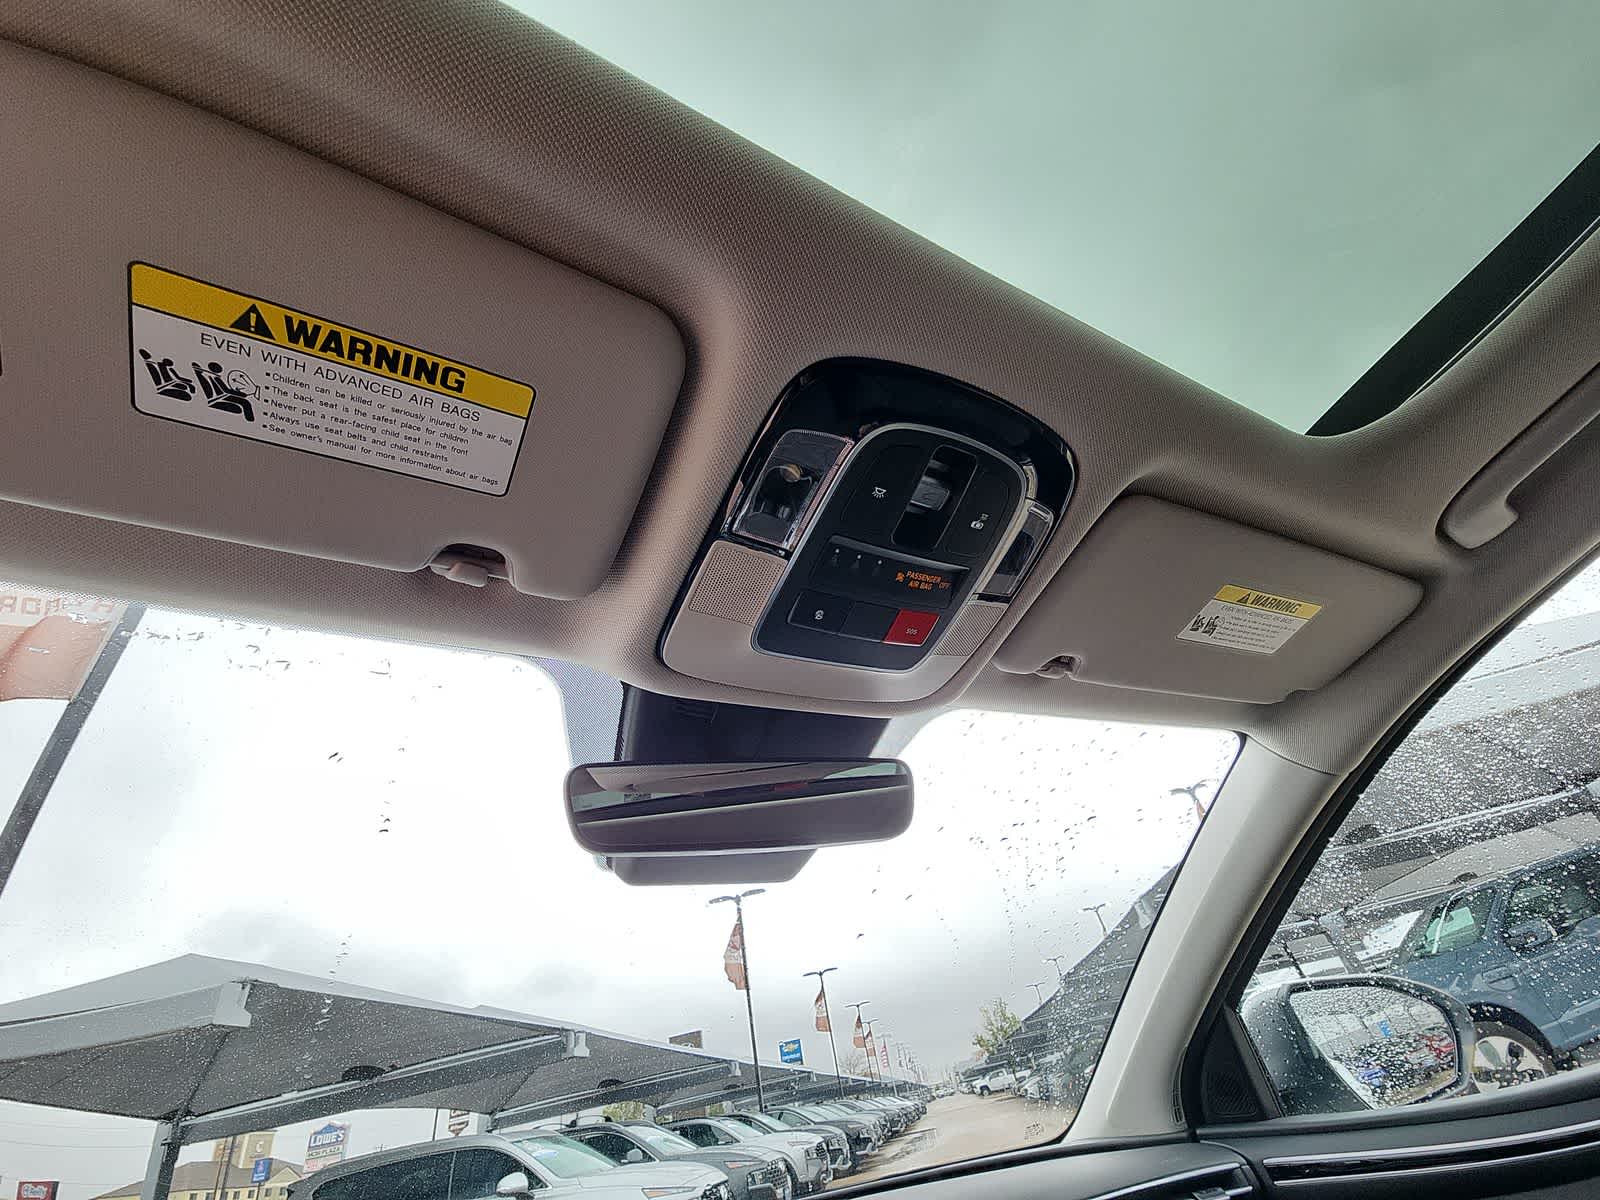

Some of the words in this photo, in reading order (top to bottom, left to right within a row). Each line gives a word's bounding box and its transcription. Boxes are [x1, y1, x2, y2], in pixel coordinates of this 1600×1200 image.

[200, 332, 251, 358] EVEN
[261, 350, 306, 373] WITH
[313, 367, 403, 399] ADVANCED
[408, 394, 434, 408] AIR
[441, 402, 481, 422] BAGS
[284, 315, 466, 394] WARNING
[271, 400, 297, 412] Never
[301, 408, 316, 417] put
[330, 416, 377, 434] rear-facing
[381, 428, 400, 438] child
[404, 435, 420, 444] seat
[425, 438, 431, 446] in
[436, 441, 447, 450] the
[451, 446, 468, 456] front
[272, 372, 310, 389] Children
[315, 386, 331, 395] can
[335, 390, 346, 399] be
[350, 394, 373, 406] killed
[392, 406, 426, 422] seriously
[429, 416, 456, 429] injured
[459, 424, 468, 433] by
[472, 428, 484, 436] the
[500, 437, 513, 446] bag
[272, 386, 288, 397] The
[294, 392, 314, 404] back
[319, 400, 338, 410] seat
[354, 409, 368, 418] the
[372, 414, 397, 425] safest
[401, 422, 421, 432] place
[426, 428, 436, 436] for
[440, 432, 469, 445] children
[269, 424, 285, 434] See
[291, 430, 322, 443] owner's
[326, 439, 356, 451] manual
[360, 447, 372, 455] for
[376, 452, 396, 460] more
[400, 456, 442, 472] information
[445, 467, 466, 478] about
[482, 476, 498, 486] bags
[270, 412, 300, 425] Always
[305, 422, 320, 430] use
[325, 427, 343, 436] seat
[347, 432, 367, 442] belts
[372, 437, 386, 447] and
[390, 442, 408, 452] child
[412, 448, 448, 462] restraints
[906, 571, 942, 583] PASSENGER
[908, 581, 919, 589] AIR
[920, 582, 933, 590] BAG
[938, 582, 952, 590] OFF
[1250, 594, 1302, 614] WARNING
[906, 628, 918, 636] SOS
[310, 1130, 345, 1146] LOWE'S
